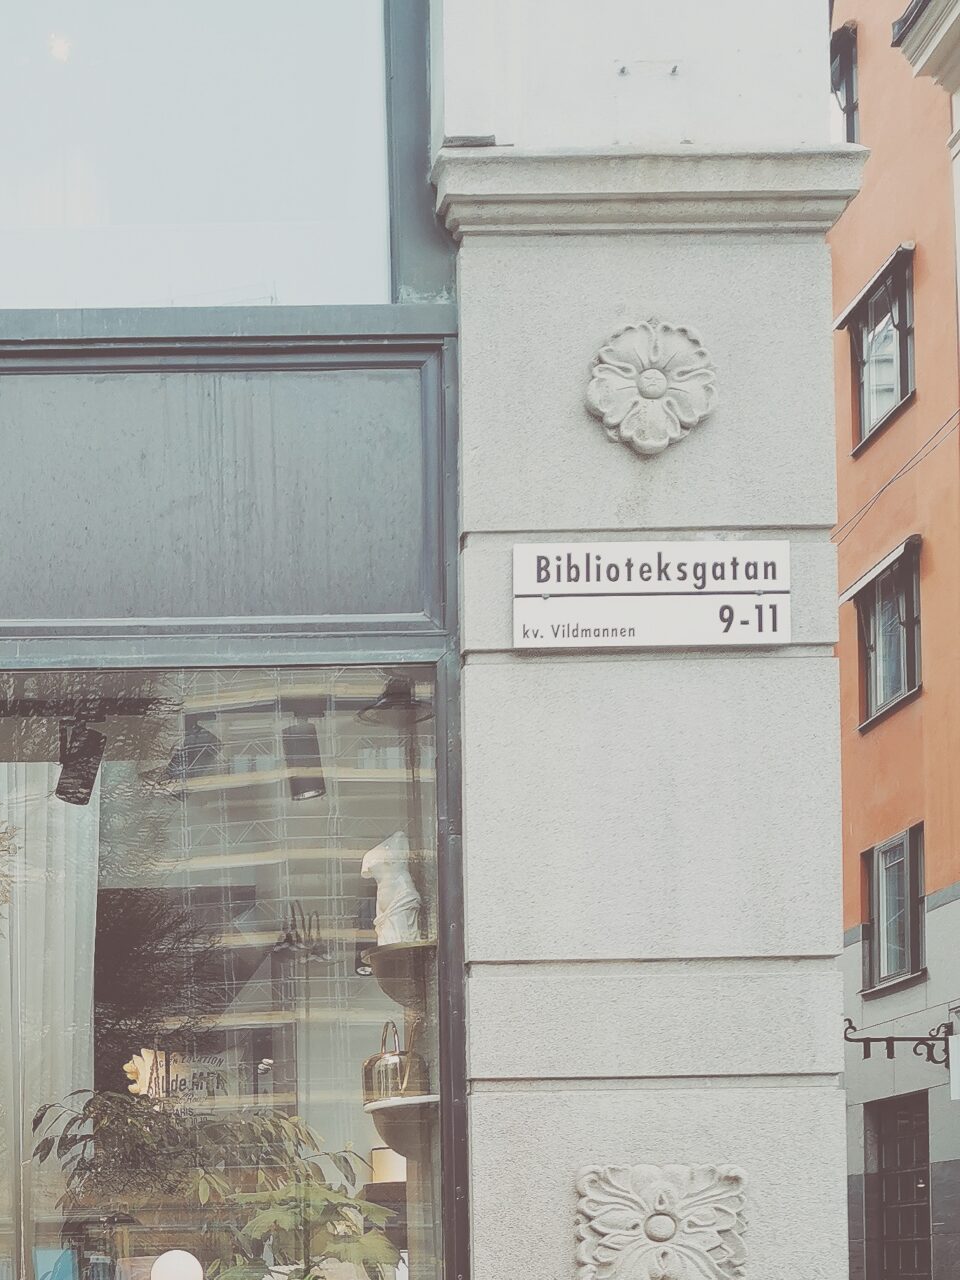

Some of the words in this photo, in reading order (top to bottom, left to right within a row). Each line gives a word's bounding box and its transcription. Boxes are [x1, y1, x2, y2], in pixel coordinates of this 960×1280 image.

[536, 552, 777, 590] Biblioteksgatan
[522, 624, 544, 639] kv.
[551, 624, 636, 639] Vildmannen
[718, 604, 778, 633] 9-11
